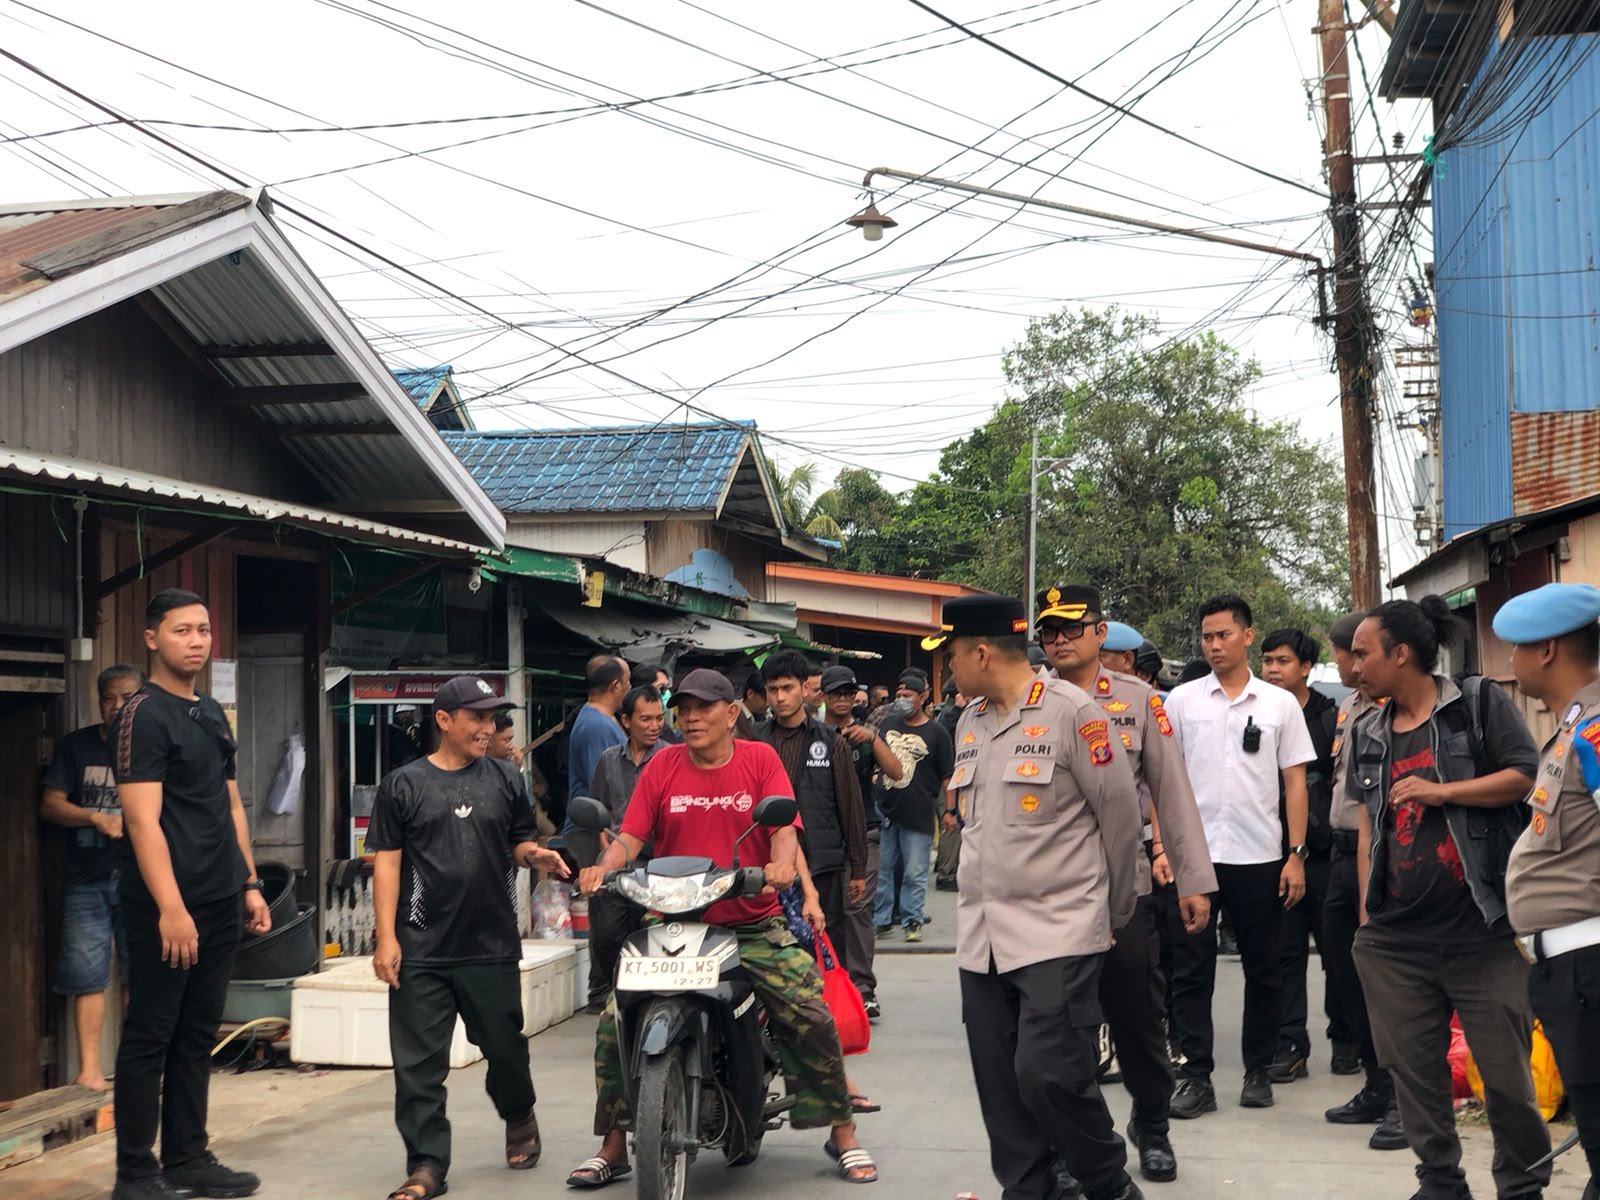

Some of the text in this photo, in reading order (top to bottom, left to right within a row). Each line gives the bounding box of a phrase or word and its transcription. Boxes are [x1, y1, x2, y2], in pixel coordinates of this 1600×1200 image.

[1110, 717, 1136, 726] OLRI
[1015, 744, 1051, 755] POLRI
[806, 760, 830, 768] HUMAS
[624, 960, 715, 974] KT 5001 WS
